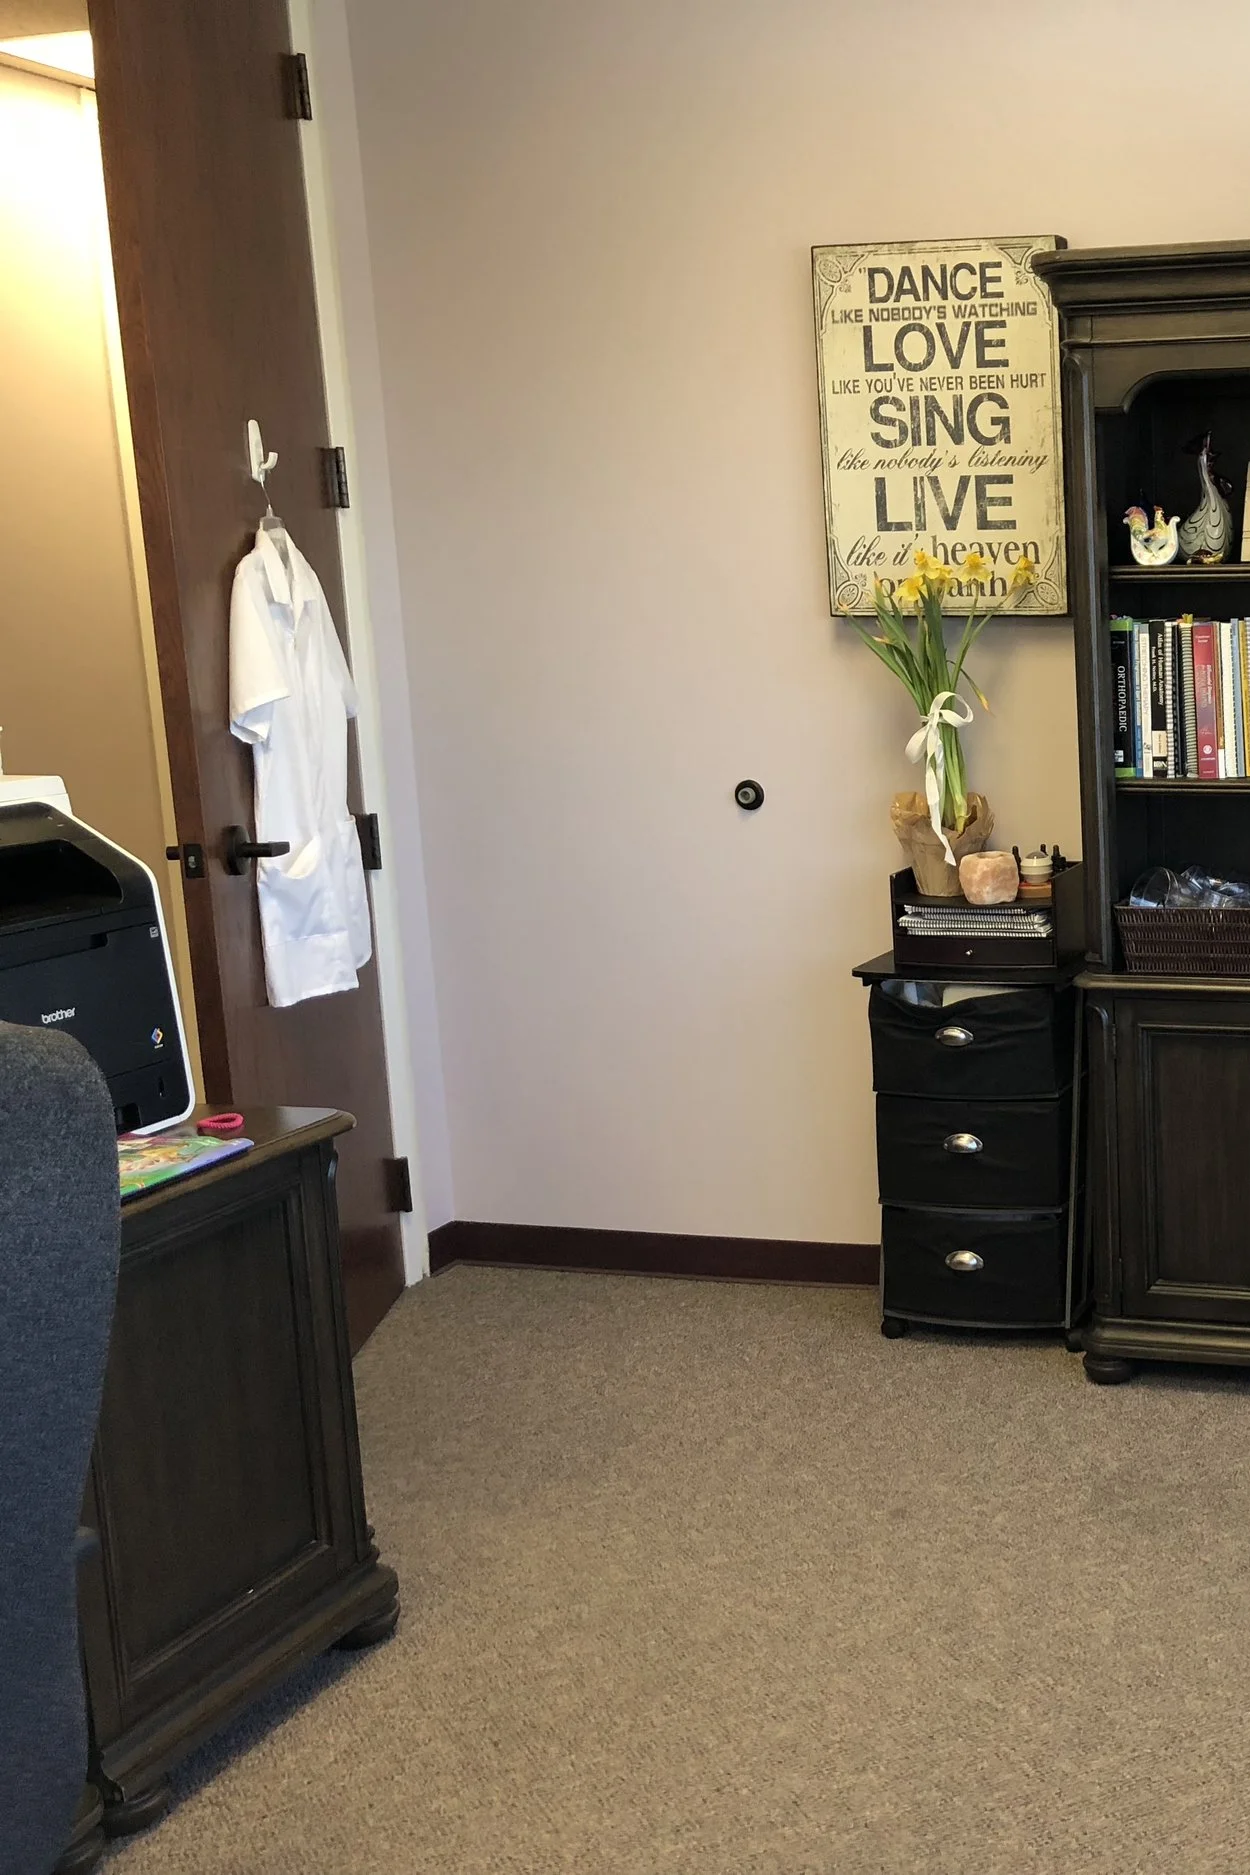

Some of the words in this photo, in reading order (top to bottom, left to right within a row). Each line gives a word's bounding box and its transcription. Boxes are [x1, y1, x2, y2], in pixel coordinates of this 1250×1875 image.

[831, 308, 863, 324] LIKE
[869, 305, 947, 323] NOBODY'S
[952, 301, 1037, 319] WATCHING
[863, 320, 1009, 372] LOVE
[832, 379, 860, 394] LIKE
[865, 373, 914, 393] YOU'VE
[920, 375, 963, 392] NEVER
[970, 374, 1005, 390] BEEN
[1010, 373, 1047, 389] HURT
[870, 392, 1011, 449] SING
[837, 448, 870, 471] like
[873, 446, 960, 476] nobody's
[968, 445, 1049, 474] listening
[874, 474, 1017, 532] LIVE
[846, 535, 887, 567] like
[1117, 665, 1127, 732] ORTHOPAEDIC
[41, 1007, 76, 1024] brother
